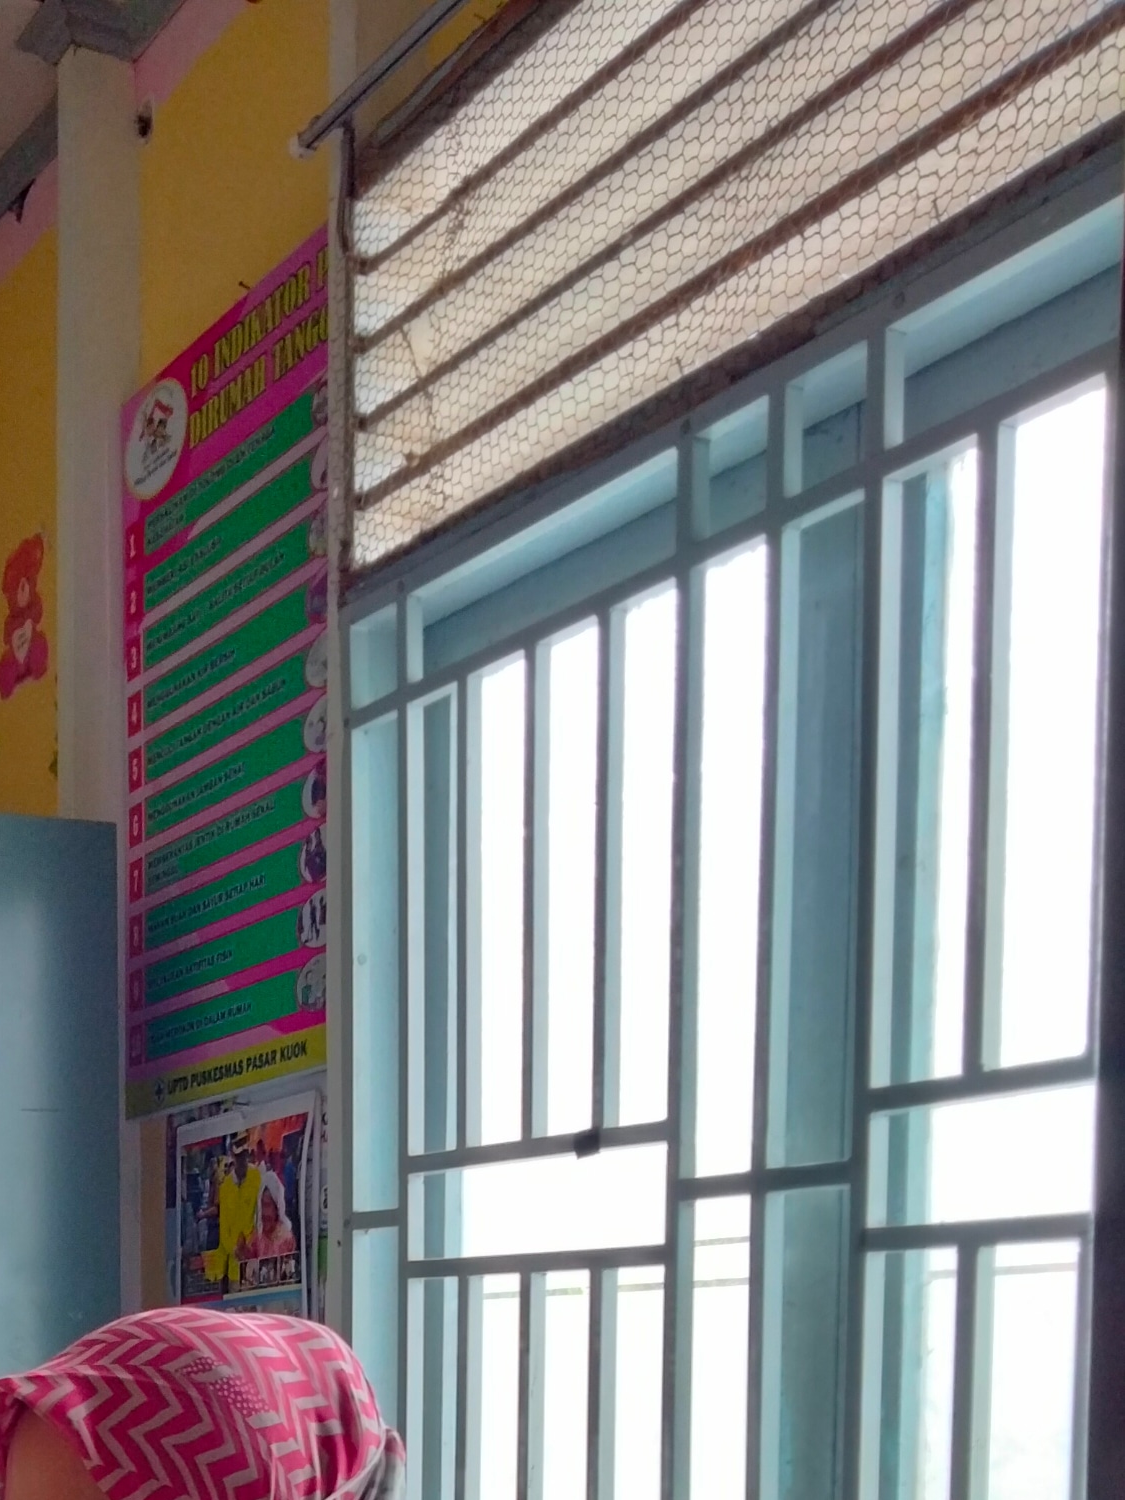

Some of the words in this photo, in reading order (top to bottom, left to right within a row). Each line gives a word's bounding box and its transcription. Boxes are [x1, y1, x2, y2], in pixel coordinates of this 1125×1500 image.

[214, 261, 311, 379] INDIKATOR
[167, 1076, 188, 1095] UPTD
[190, 1058, 244, 1088] PUSKESMAS
[245, 1047, 277, 1073] PASAR
[279, 1038, 307, 1061] KUOK
